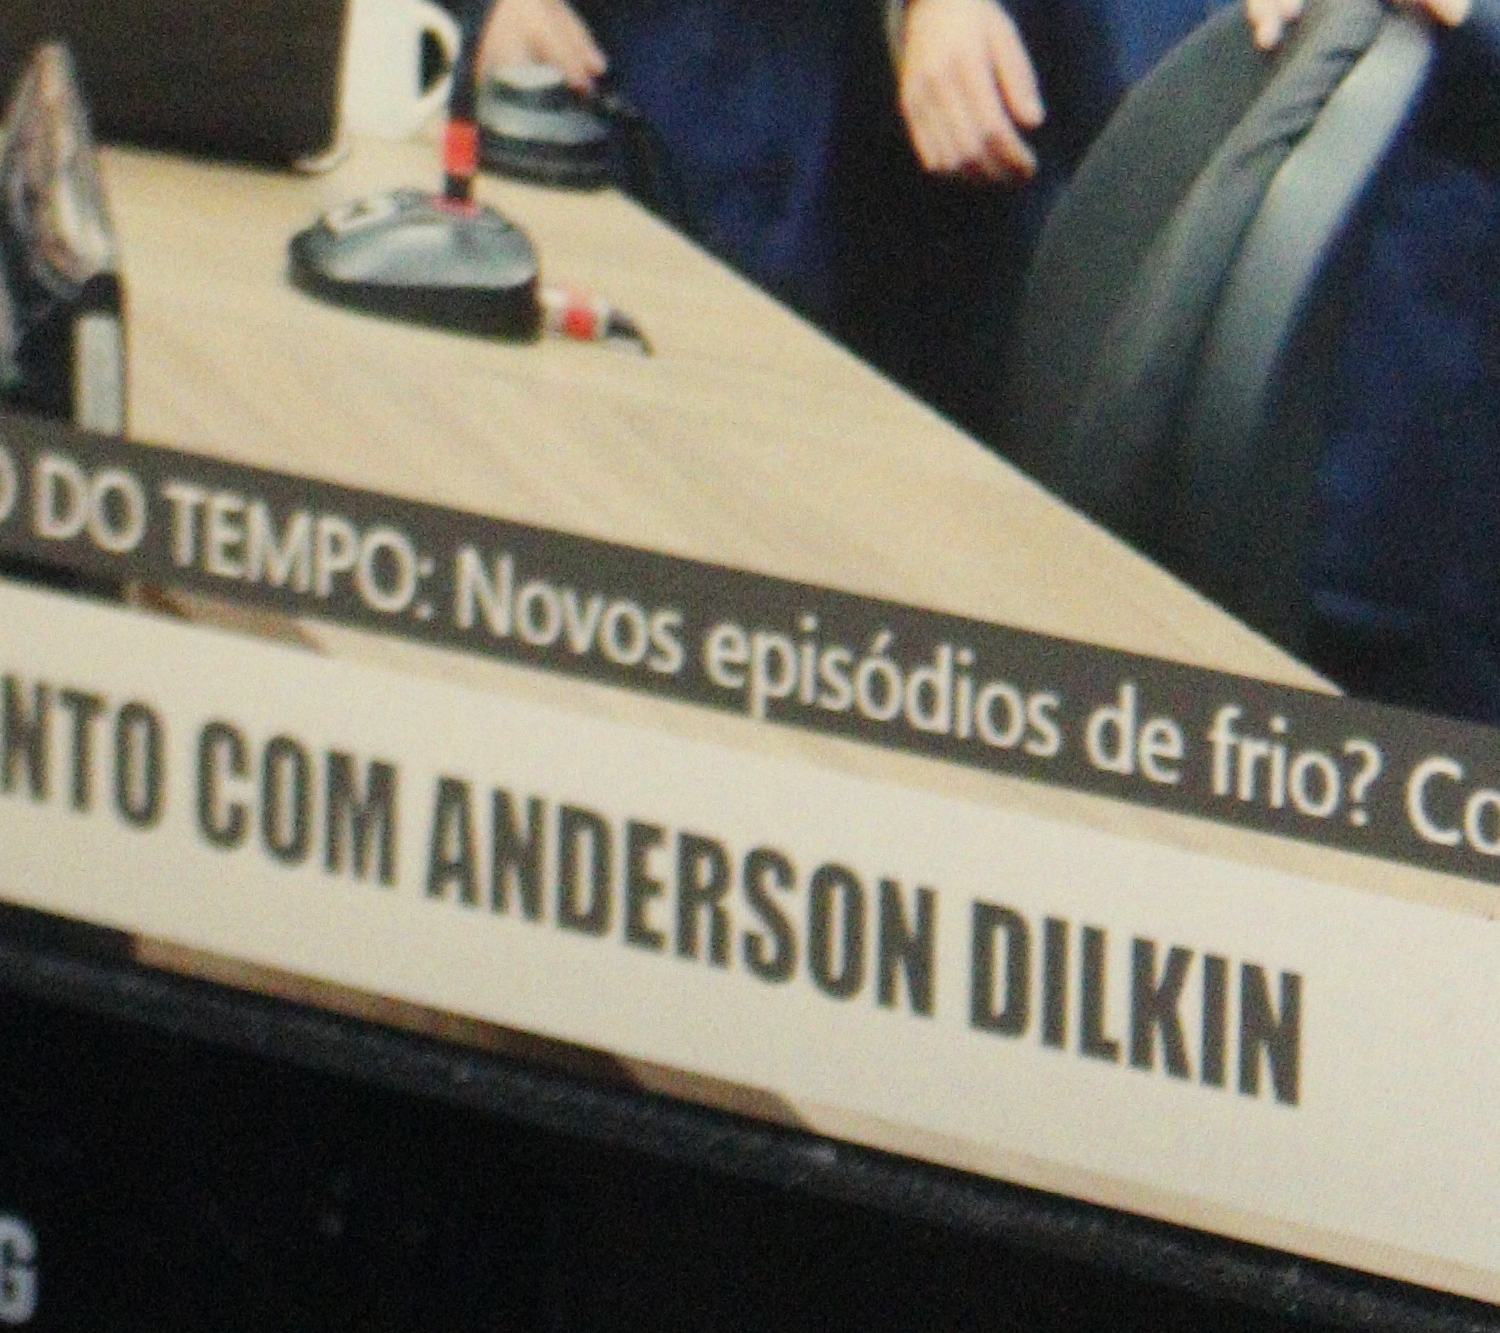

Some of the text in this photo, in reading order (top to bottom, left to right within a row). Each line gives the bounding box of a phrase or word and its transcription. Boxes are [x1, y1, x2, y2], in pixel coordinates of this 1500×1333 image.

[33, 457, 146, 553] DO
[164, 481, 436, 619] TEMPO:
[452, 543, 684, 675] Novos
[704, 615, 1062, 757] episódios
[1086, 683, 1184, 785] de
[1210, 707, 1384, 827] frio?
[198, 717, 400, 889] COM
[424, 773, 936, 1019] ANDERSON
[968, 897, 1304, 1109] DILKIN
